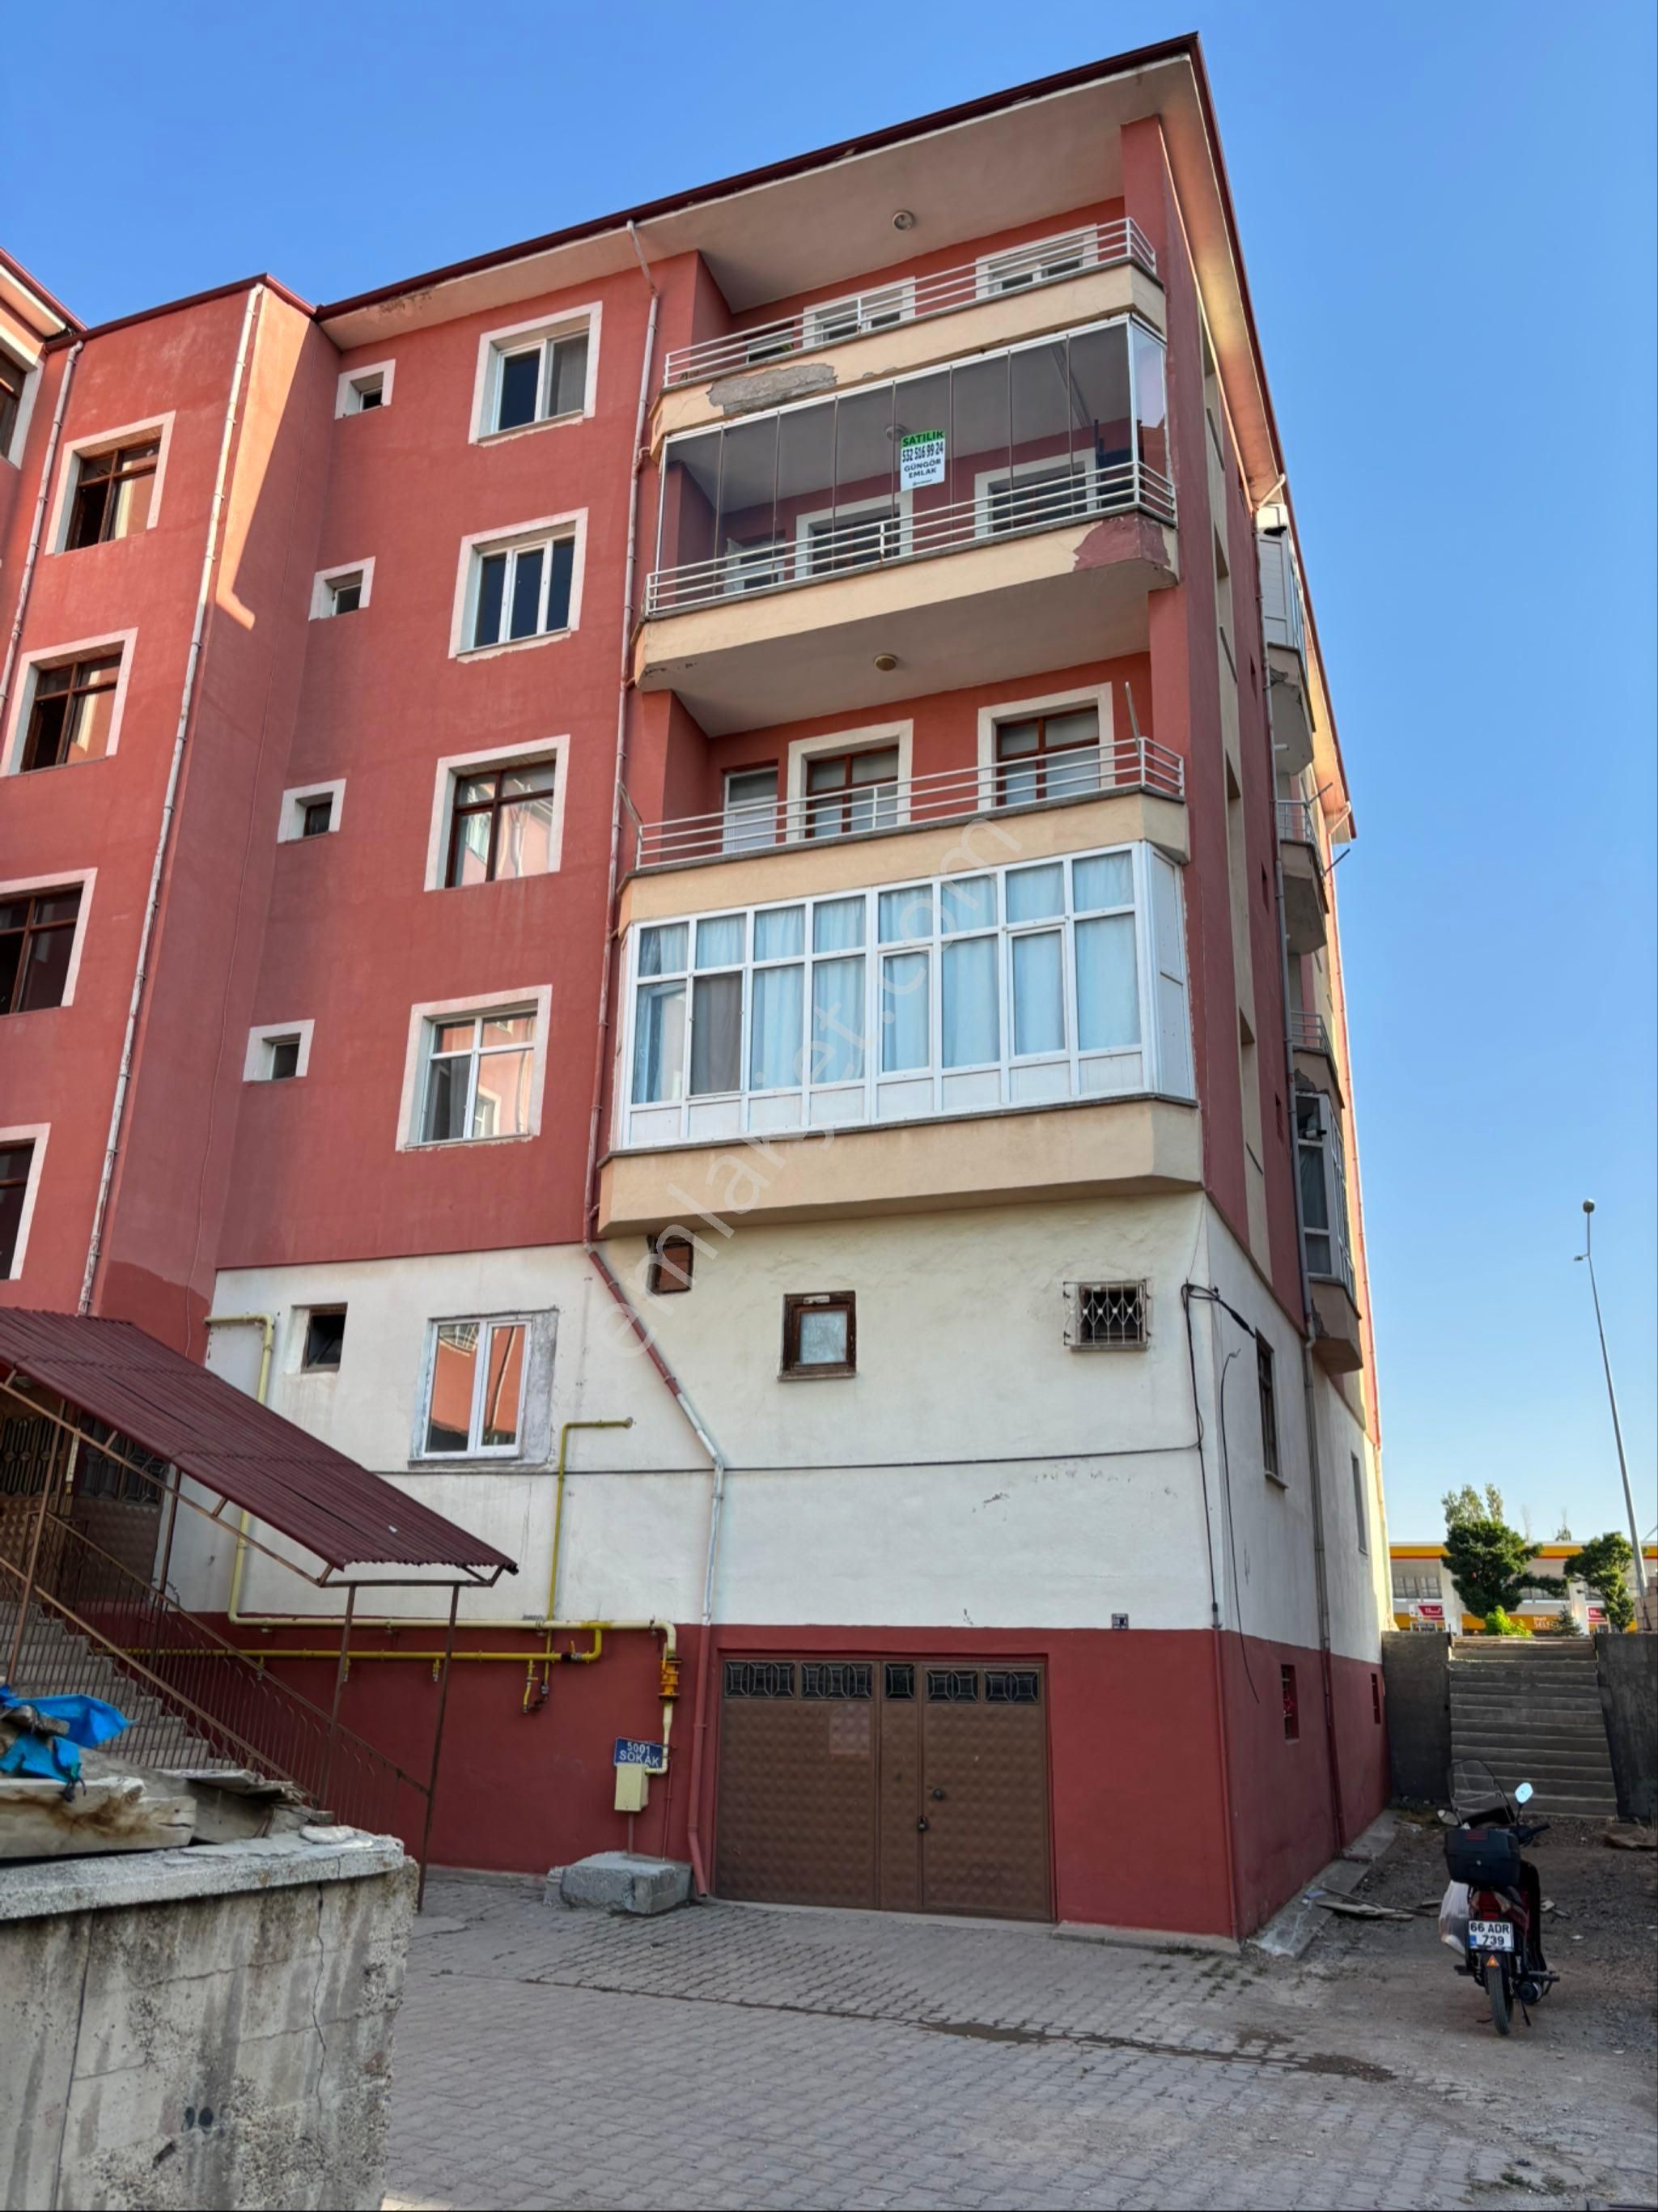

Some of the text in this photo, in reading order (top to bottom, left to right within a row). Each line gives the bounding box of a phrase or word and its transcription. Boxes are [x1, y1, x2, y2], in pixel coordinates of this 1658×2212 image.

[902, 431, 944, 447] SATILIK
[902, 448, 914, 463] 532
[908, 467, 937, 478] EMLAK
[627, 1741, 650, 1754] 5001
[618, 1750, 659, 1767] SOKAK
[1470, 1922, 1510, 1934] 66 ADR
[1482, 1934, 1504, 1946] 739
